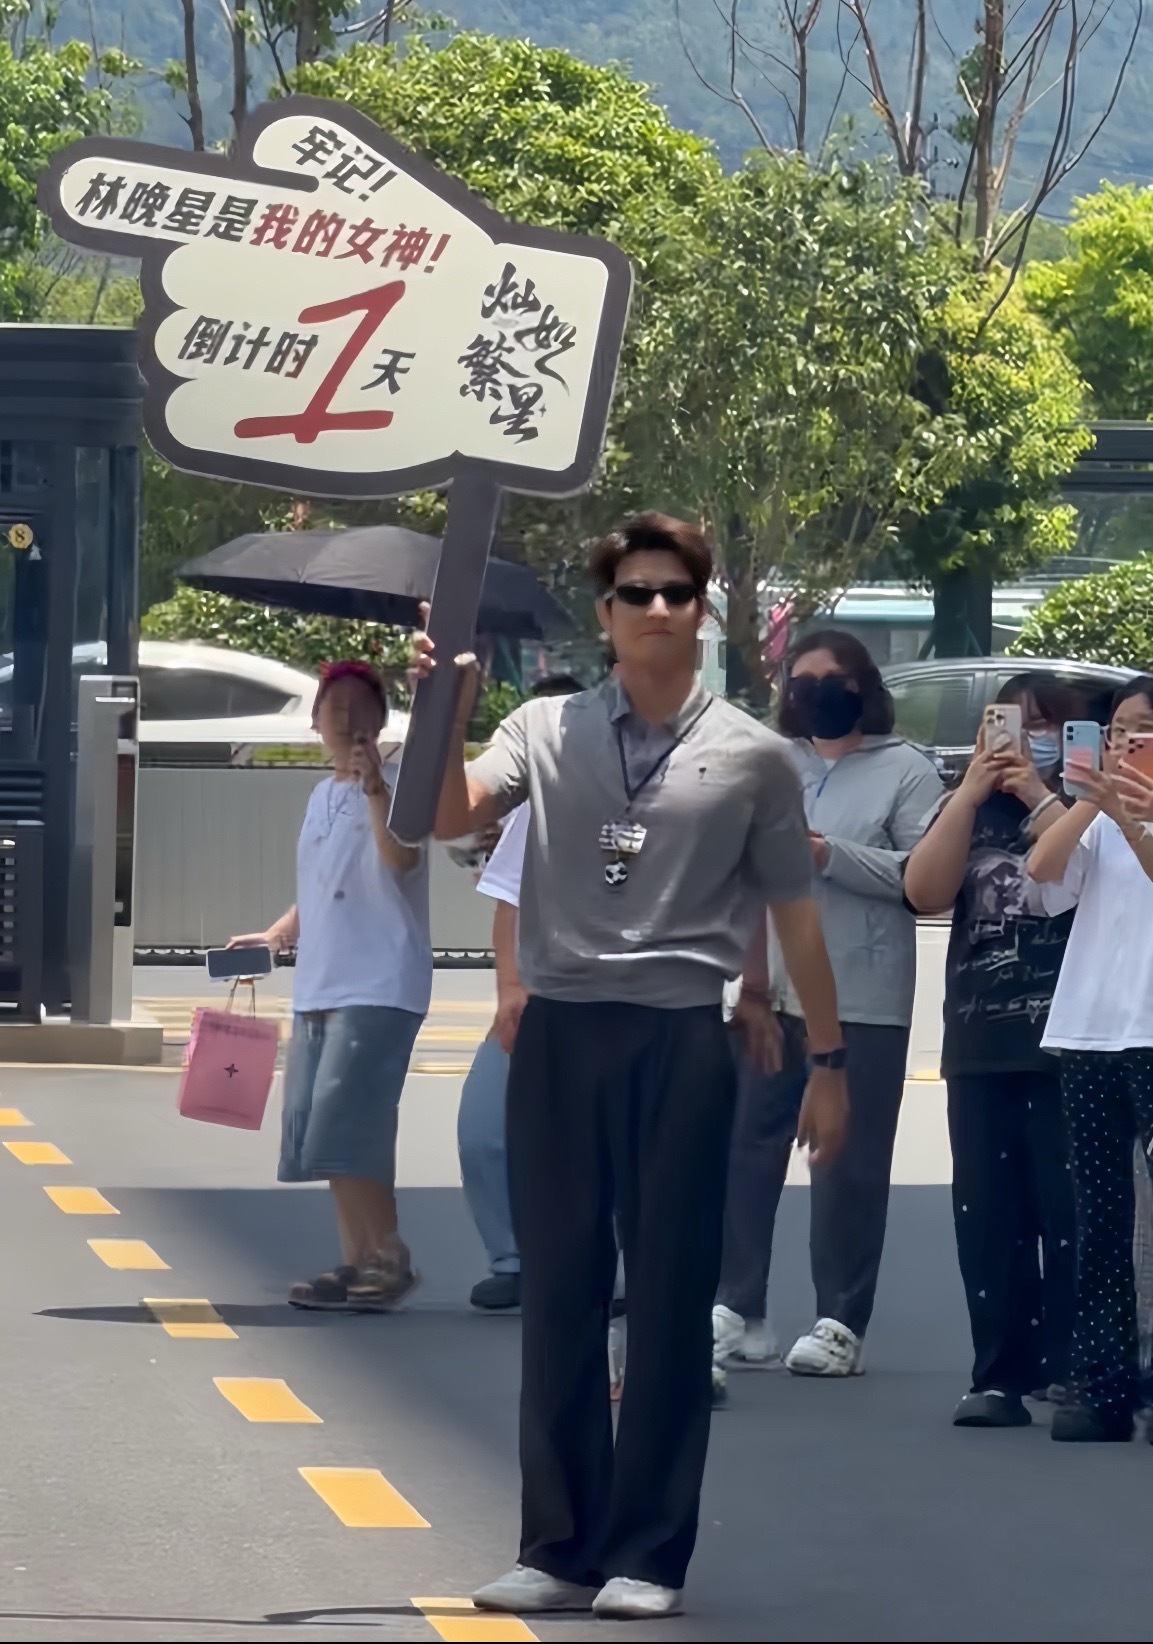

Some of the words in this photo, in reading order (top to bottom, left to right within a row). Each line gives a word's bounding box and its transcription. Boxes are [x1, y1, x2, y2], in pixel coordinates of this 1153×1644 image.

[177, 315, 320, 379] 倒计时
[233, 280, 406, 444] 1
[360, 348, 417, 395] 天
